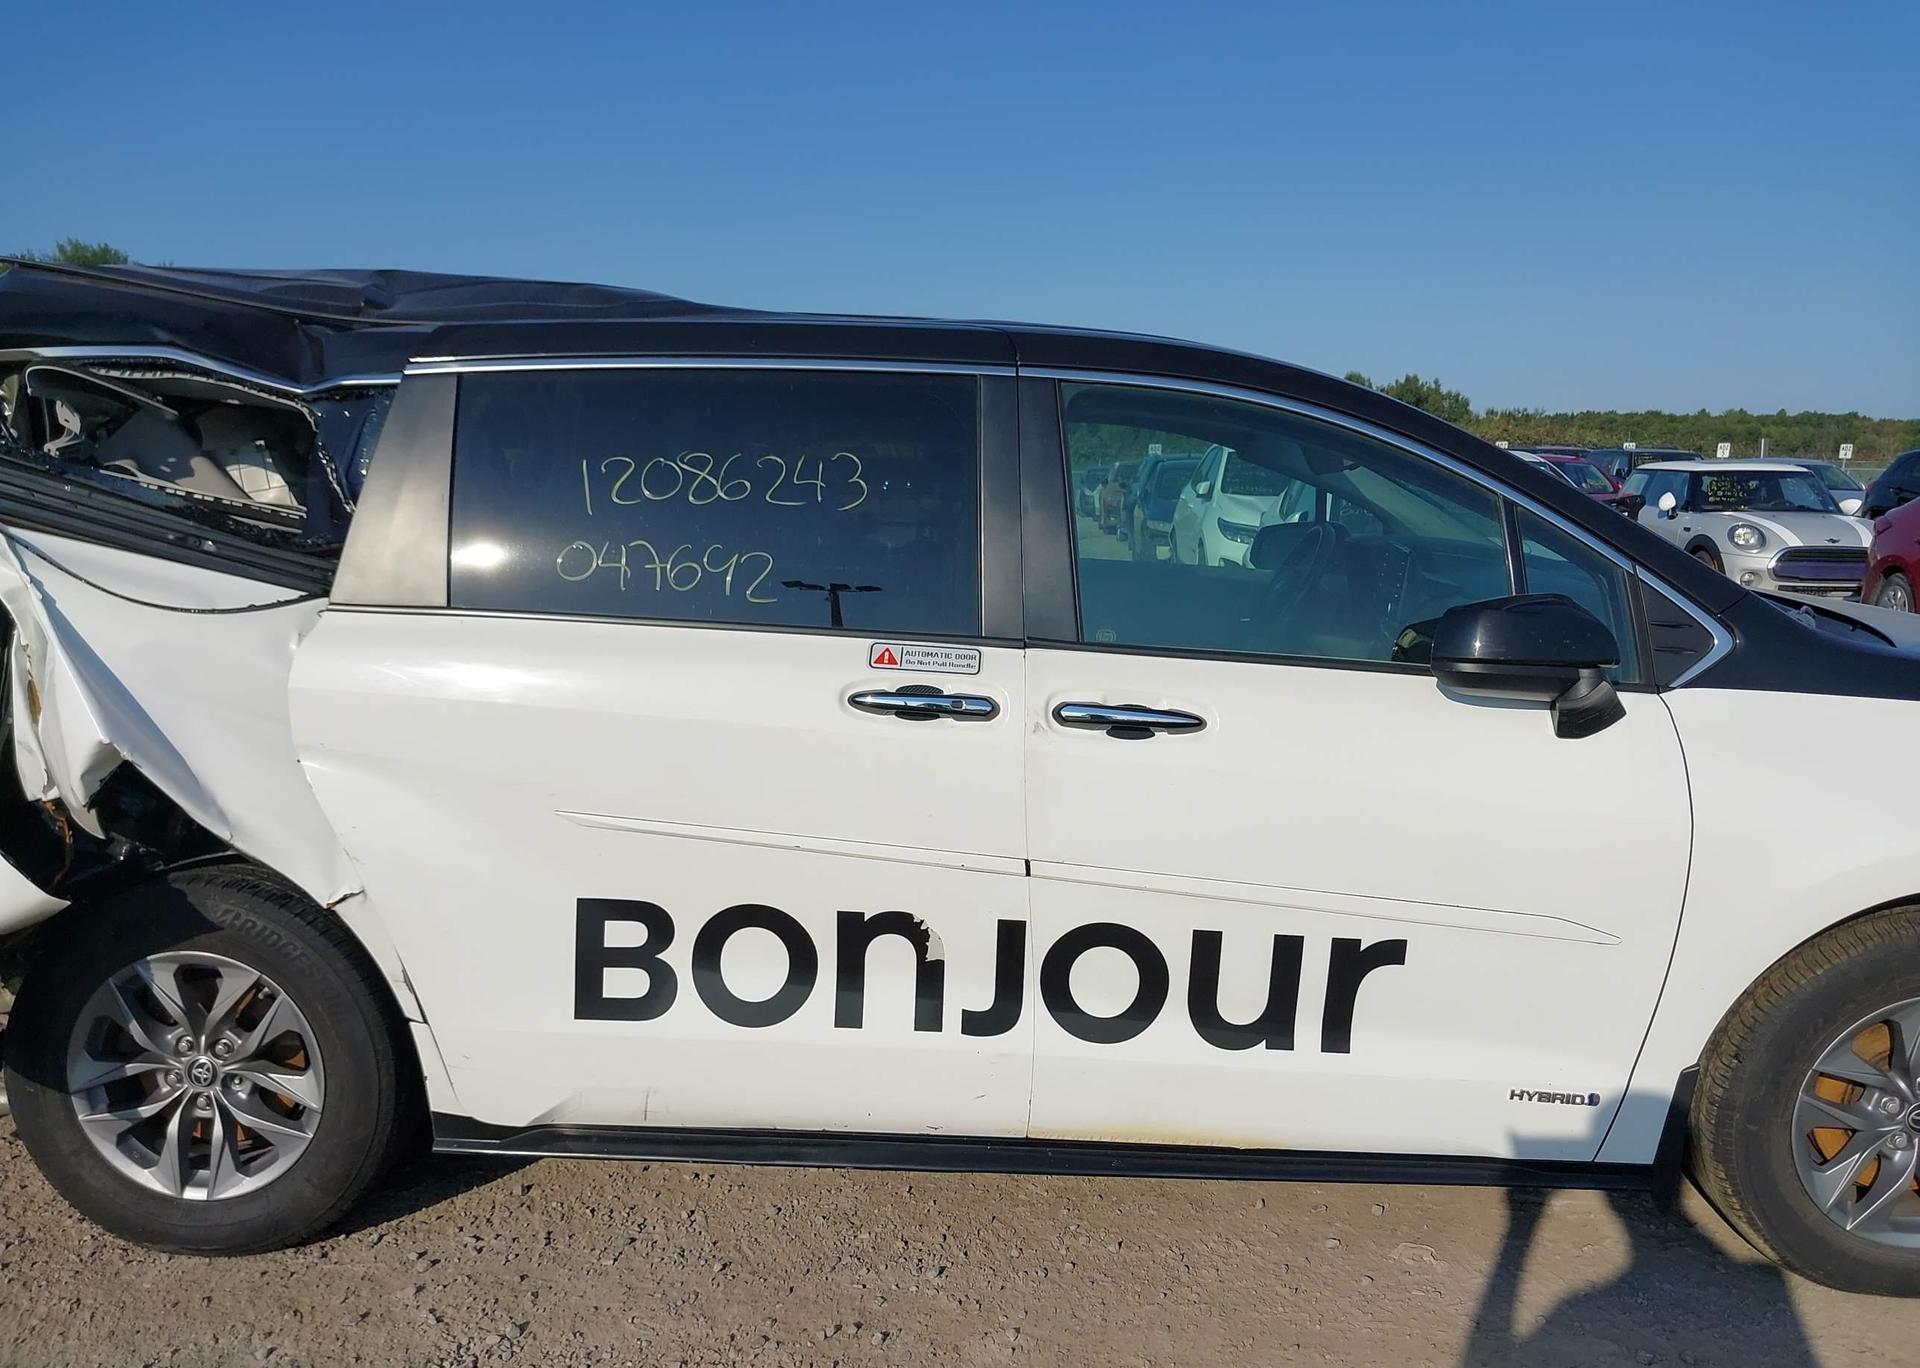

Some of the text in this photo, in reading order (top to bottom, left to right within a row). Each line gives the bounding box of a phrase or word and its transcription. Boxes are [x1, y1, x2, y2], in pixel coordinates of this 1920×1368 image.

[582, 452, 868, 516] 12086243
[904, 650, 977, 661] AUTOMATIC DOOR
[1509, 1089, 1587, 1106] HYBRID
